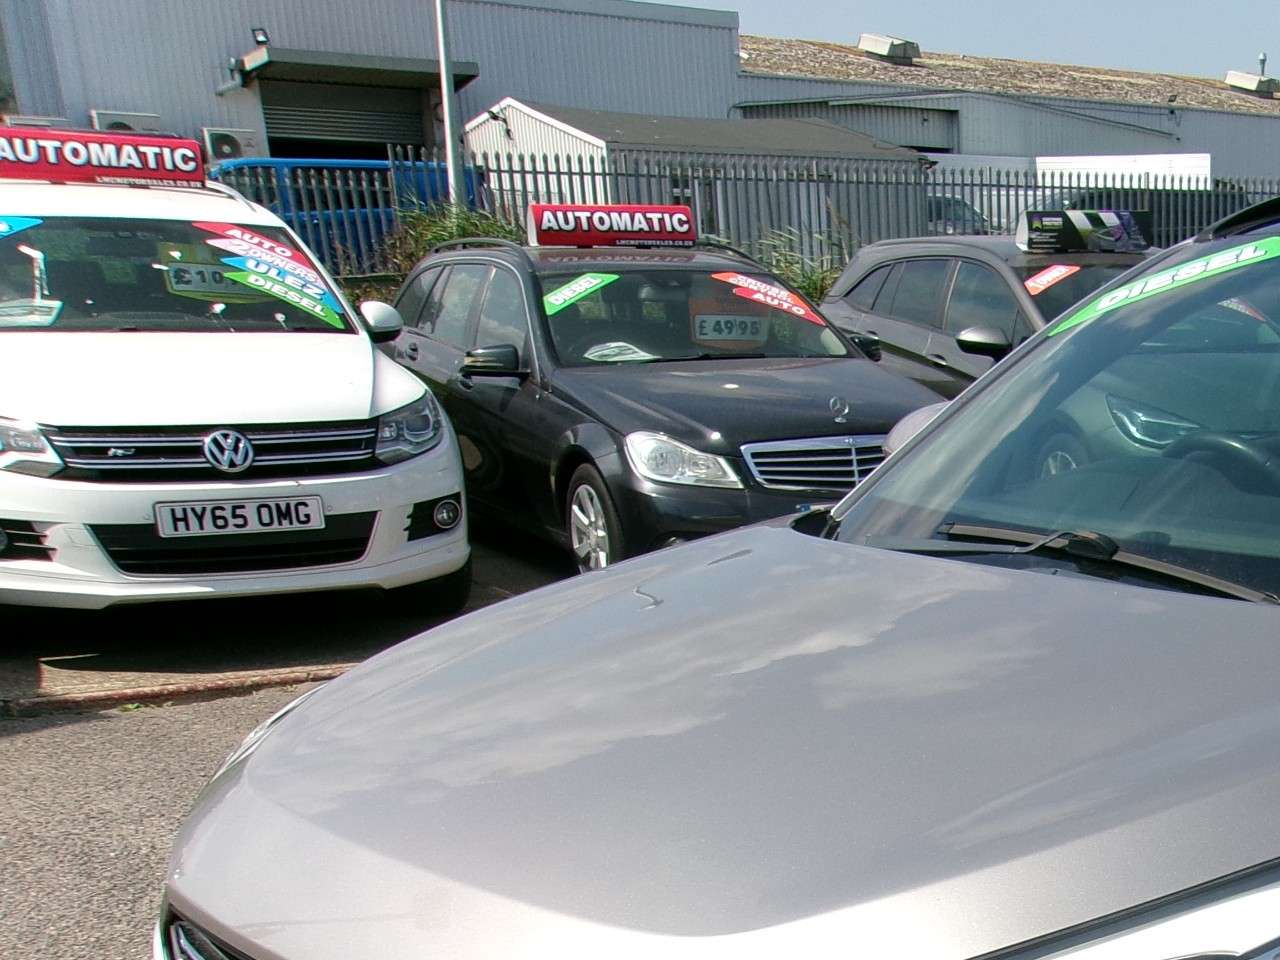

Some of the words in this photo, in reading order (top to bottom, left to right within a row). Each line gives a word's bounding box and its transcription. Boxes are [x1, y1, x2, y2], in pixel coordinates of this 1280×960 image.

[0, 136, 197, 172] AUTOMATIC
[541, 210, 690, 233] AUTOMATIC
[224, 229, 293, 257] AUTO
[245, 258, 326, 300] ULEZ
[547, 276, 604, 306] DIESEL
[1095, 245, 1269, 312] DIESEL
[247, 274, 327, 317] DIESEL
[751, 292, 806, 315] AUTO
[170, 504, 249, 532] HY65
[256, 501, 312, 527] OMG
